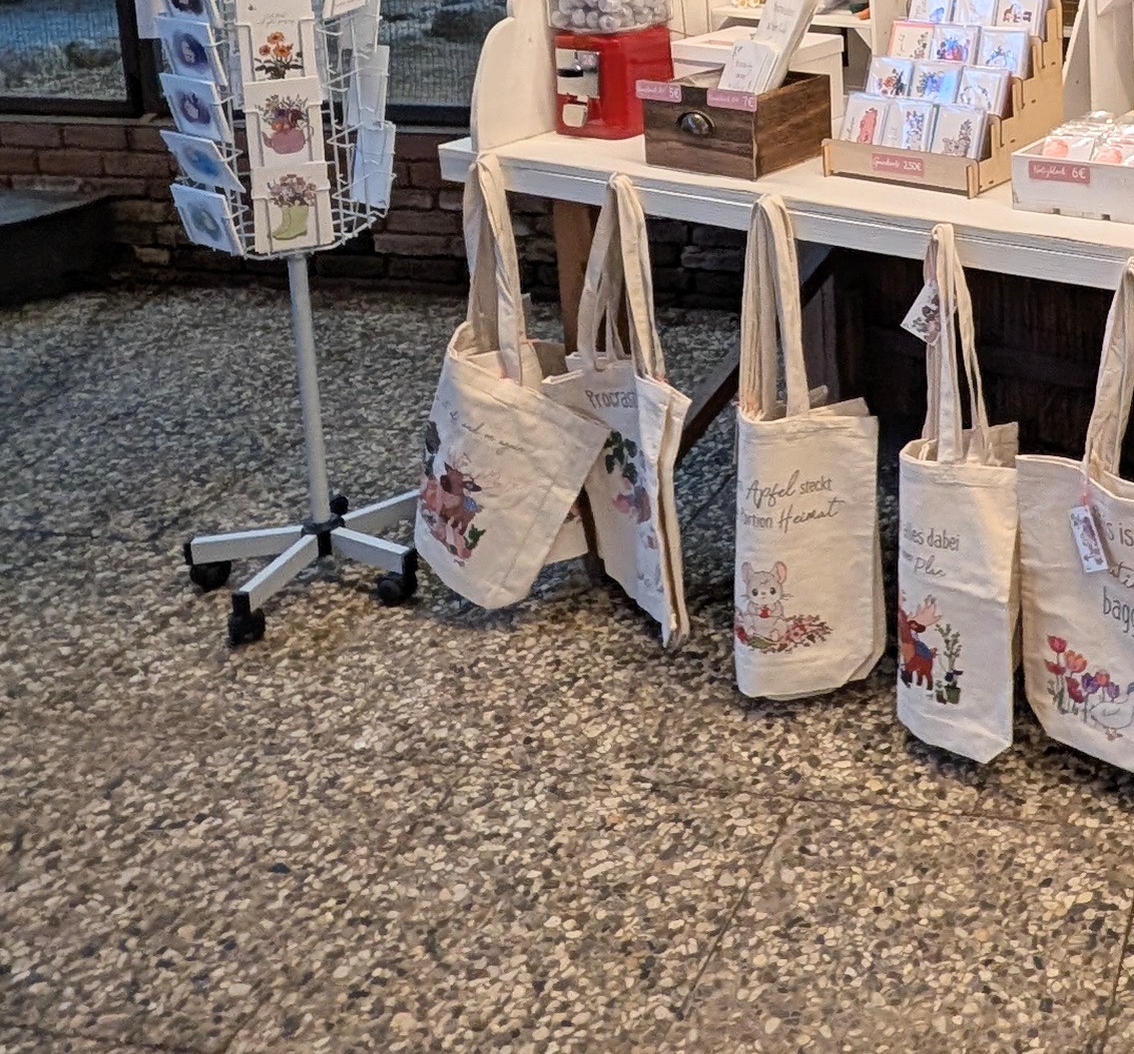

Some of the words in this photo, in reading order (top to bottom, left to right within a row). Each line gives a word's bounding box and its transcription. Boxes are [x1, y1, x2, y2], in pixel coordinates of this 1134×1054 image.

[1072, 167, 1087, 179] 6€
[746, 469, 800, 509] Apfel
[927, 528, 960, 551] dabei
[1119, 523, 1134, 547] is
